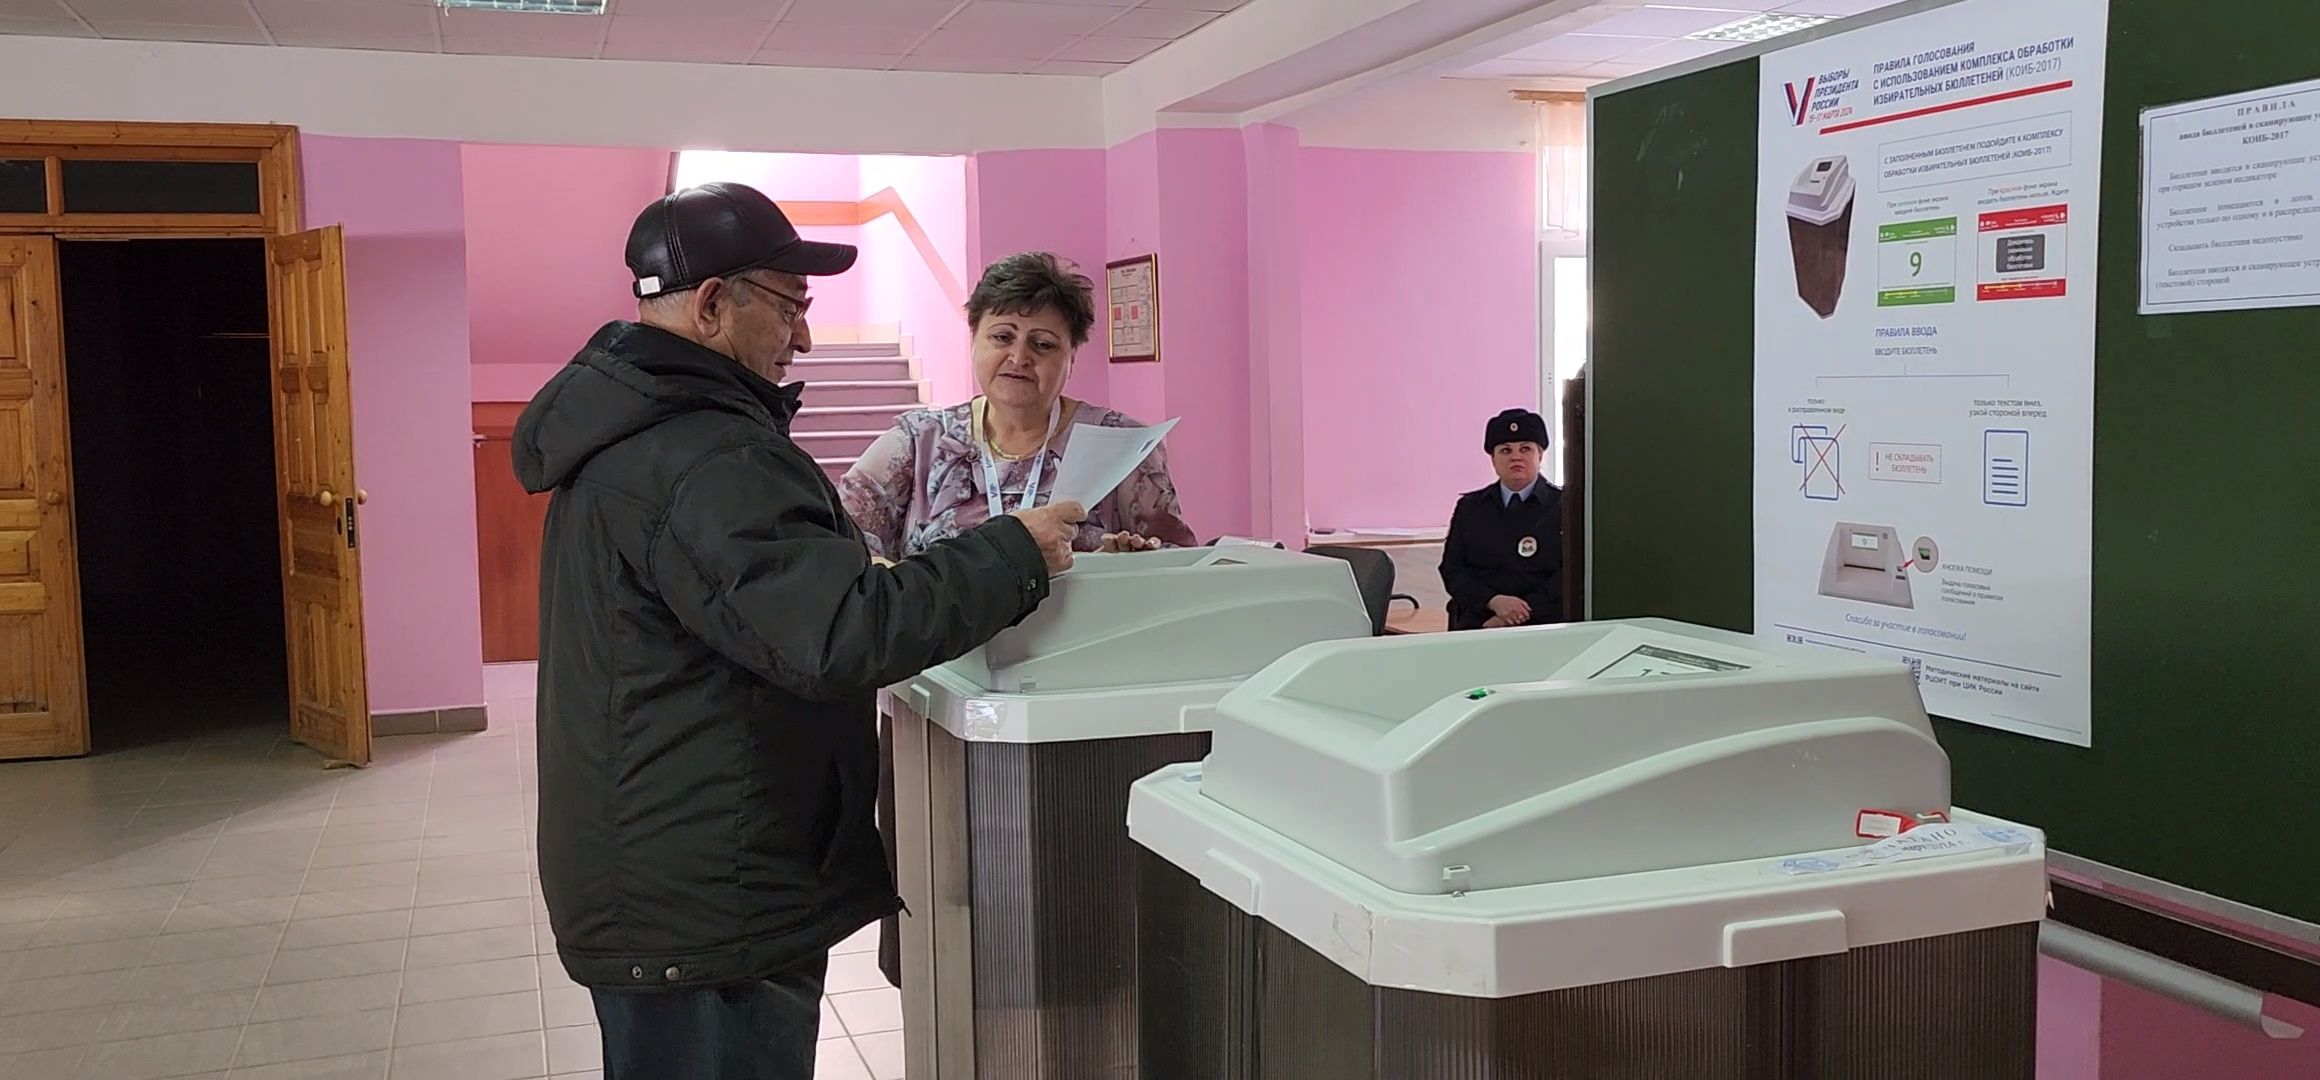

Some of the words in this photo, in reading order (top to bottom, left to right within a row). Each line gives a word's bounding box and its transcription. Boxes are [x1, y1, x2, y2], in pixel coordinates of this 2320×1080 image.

[1873, 57, 1911, 75] ПРАВИЛА
[1912, 42, 1975, 66] ГОЛОСОВАНИЯ
[1873, 80, 1879, 90] С
[1880, 63, 1958, 87] ИСПОЛЬЗОВАНИЕМ
[1960, 49, 2015, 73] КОМПЛЕКСА
[2017, 36, 2075, 60] ОБРАБОТКИ
[1818, 68, 1850, 85] ВЫБОРЫ
[1873, 84, 1943, 106] ИЗБИРАТЕЛЬНЫХ
[1945, 67, 2003, 92] БЮЛЛЕТЕНЕЙ
[2005, 56, 2062, 80] (КОИБ-2017)
[1815, 79, 1860, 98] ПРЕЗИДЕНТА
[1811, 97, 1840, 112] РОССИИ
[1890, 149, 1934, 164] ЗАПОЛНЕННЫМ
[1976, 135, 2017, 151] ПОДОЙДИТЕ
[2023, 128, 2064, 143] КОМПЛЕКСУ
[2242, 129, 2290, 145] КОИБ-2017
[1884, 164, 1918, 179] ОБРАБОТКИ
[1910, 251, 1922, 277] 9
[1875, 327, 1910, 338] ПРАВИЛА
[1911, 326, 1938, 337] ВВОДА
[1885, 452, 1894, 461] НЕ
[1845, 613, 1872, 625] Спасибо
[1880, 621, 1911, 632] участие
[1917, 626, 1967, 641] голосовании!
[1925, 664, 1971, 680] Методические
[1972, 674, 2010, 687] материалы
[2020, 684, 2040, 692] сайте
[1925, 674, 1948, 685] РЦОИТ
[1949, 680, 1962, 688] при
[1978, 685, 2003, 696] России
